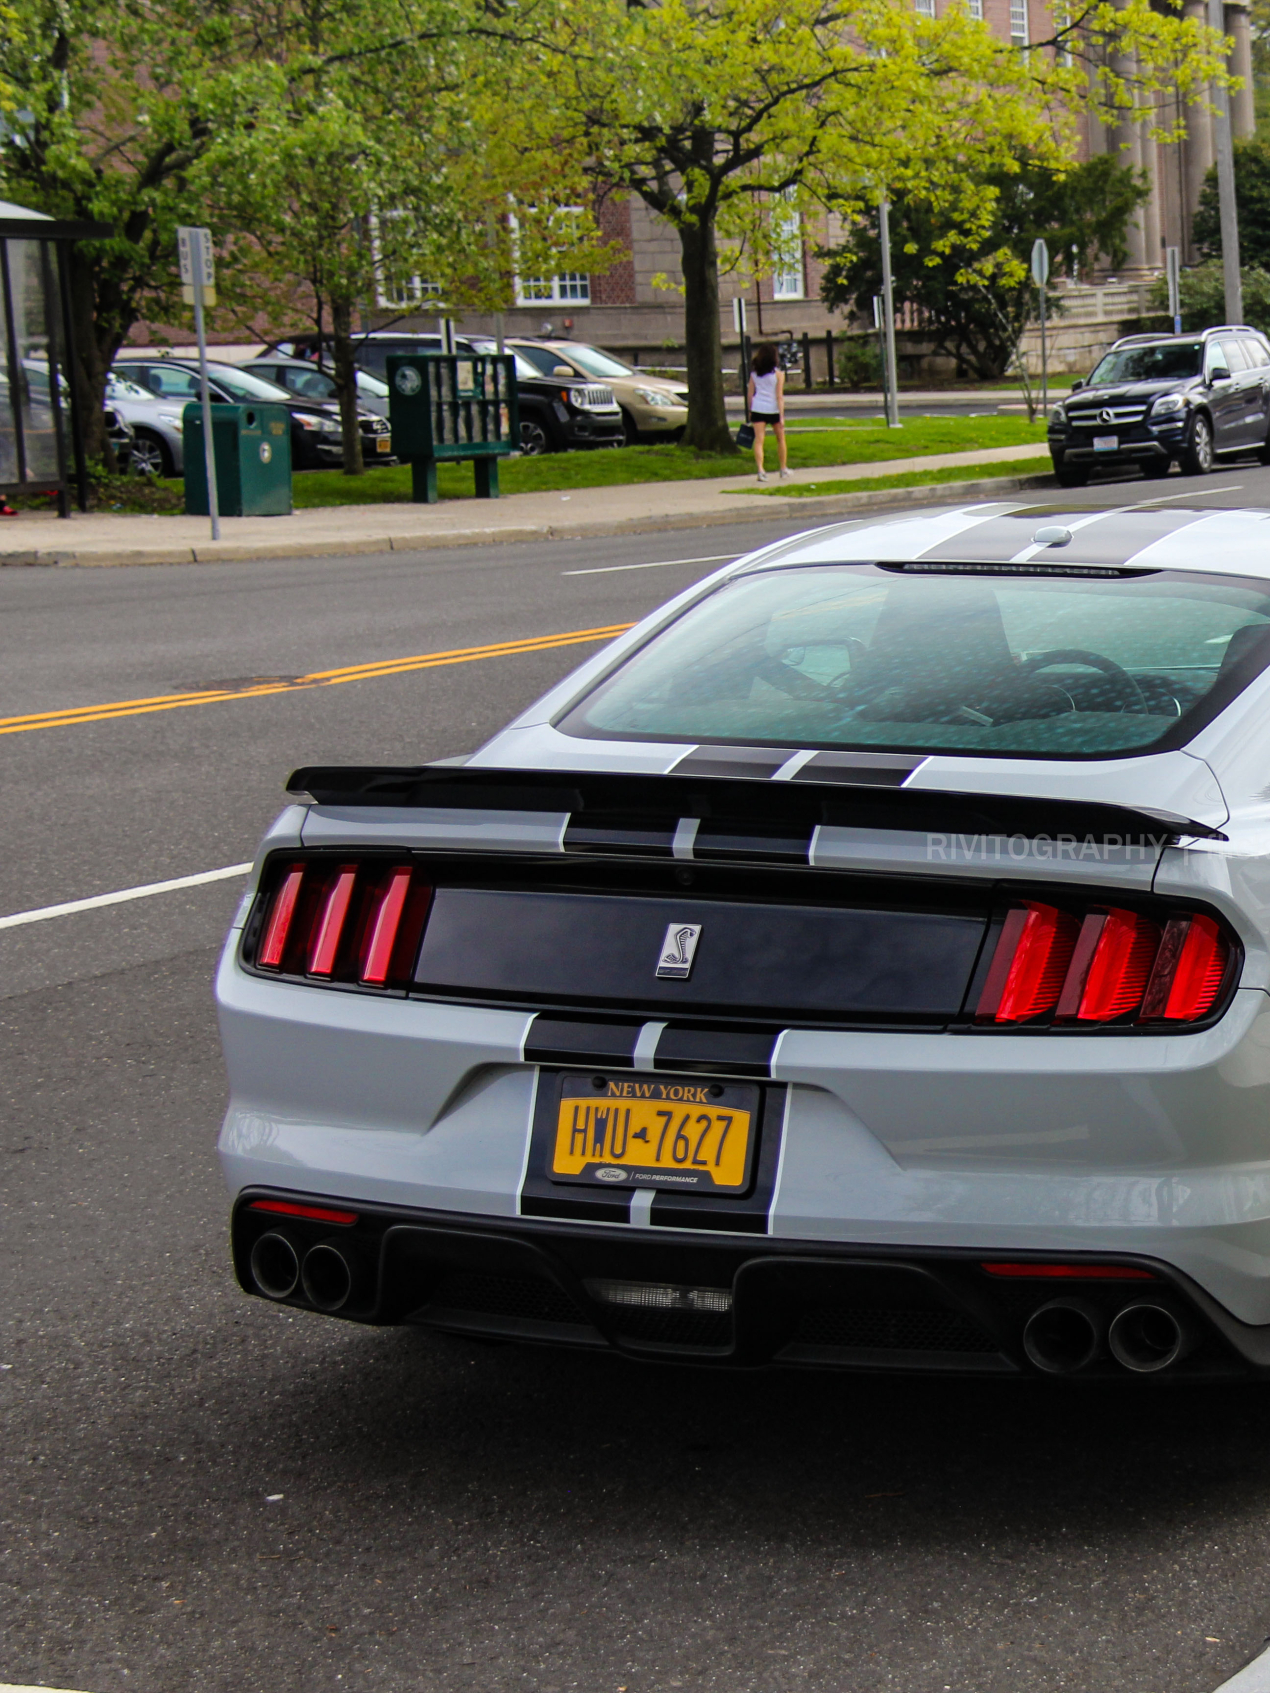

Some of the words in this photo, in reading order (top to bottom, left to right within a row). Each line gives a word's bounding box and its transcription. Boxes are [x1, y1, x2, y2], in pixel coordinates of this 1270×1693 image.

[181, 237, 189, 275] BUS
[204, 232, 213, 282] STOP
[607, 1081, 655, 1098] NEW
[659, 1084, 710, 1103] YORK
[651, 1174, 698, 1183] PERFORMANCE
